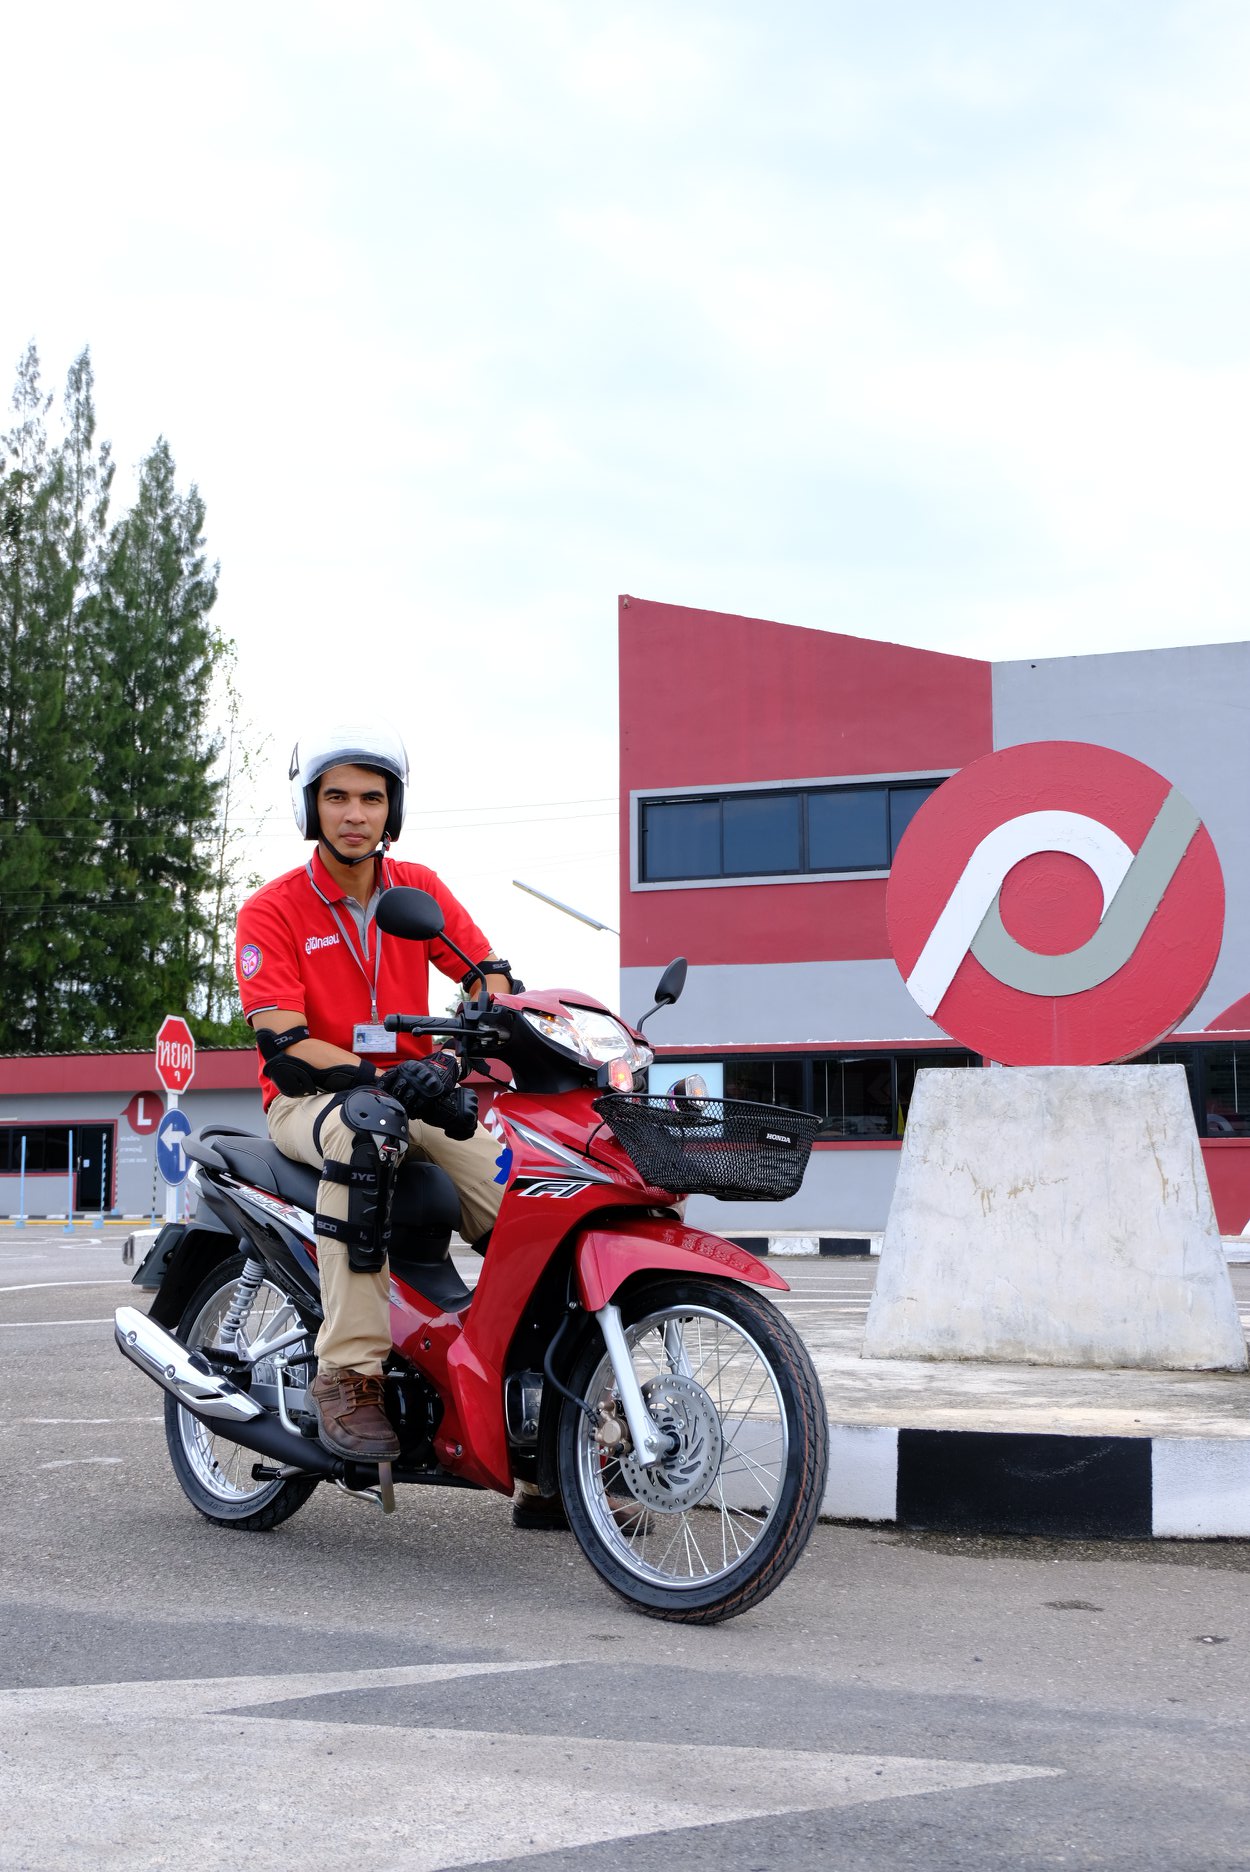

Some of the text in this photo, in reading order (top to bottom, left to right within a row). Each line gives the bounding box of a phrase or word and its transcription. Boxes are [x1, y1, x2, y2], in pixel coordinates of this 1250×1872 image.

[159, 1040, 191, 1082] หยุด
[137, 1097, 152, 1126] L
[766, 1132, 791, 1143] HONDA
[517, 1181, 593, 1199] FI
